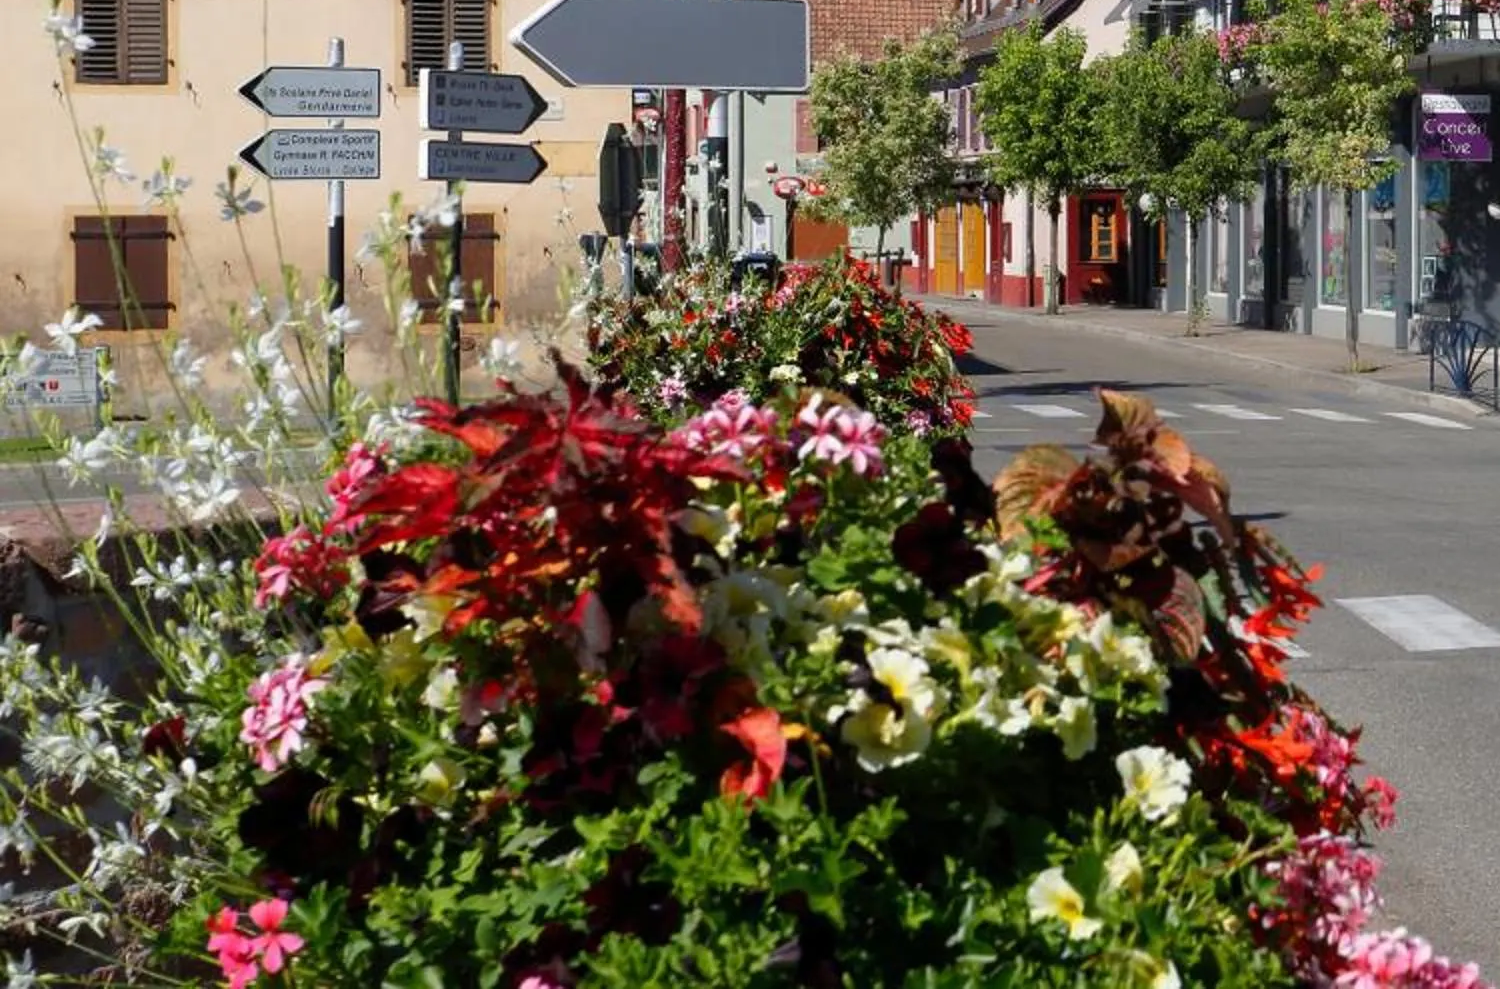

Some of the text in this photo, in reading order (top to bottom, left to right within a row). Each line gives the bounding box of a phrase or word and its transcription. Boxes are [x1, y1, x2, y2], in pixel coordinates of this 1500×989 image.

[297, 100, 373, 111] Gendarmerie
[291, 134, 376, 146] Complexe Sportif
[1442, 138, 1472, 154] Live
